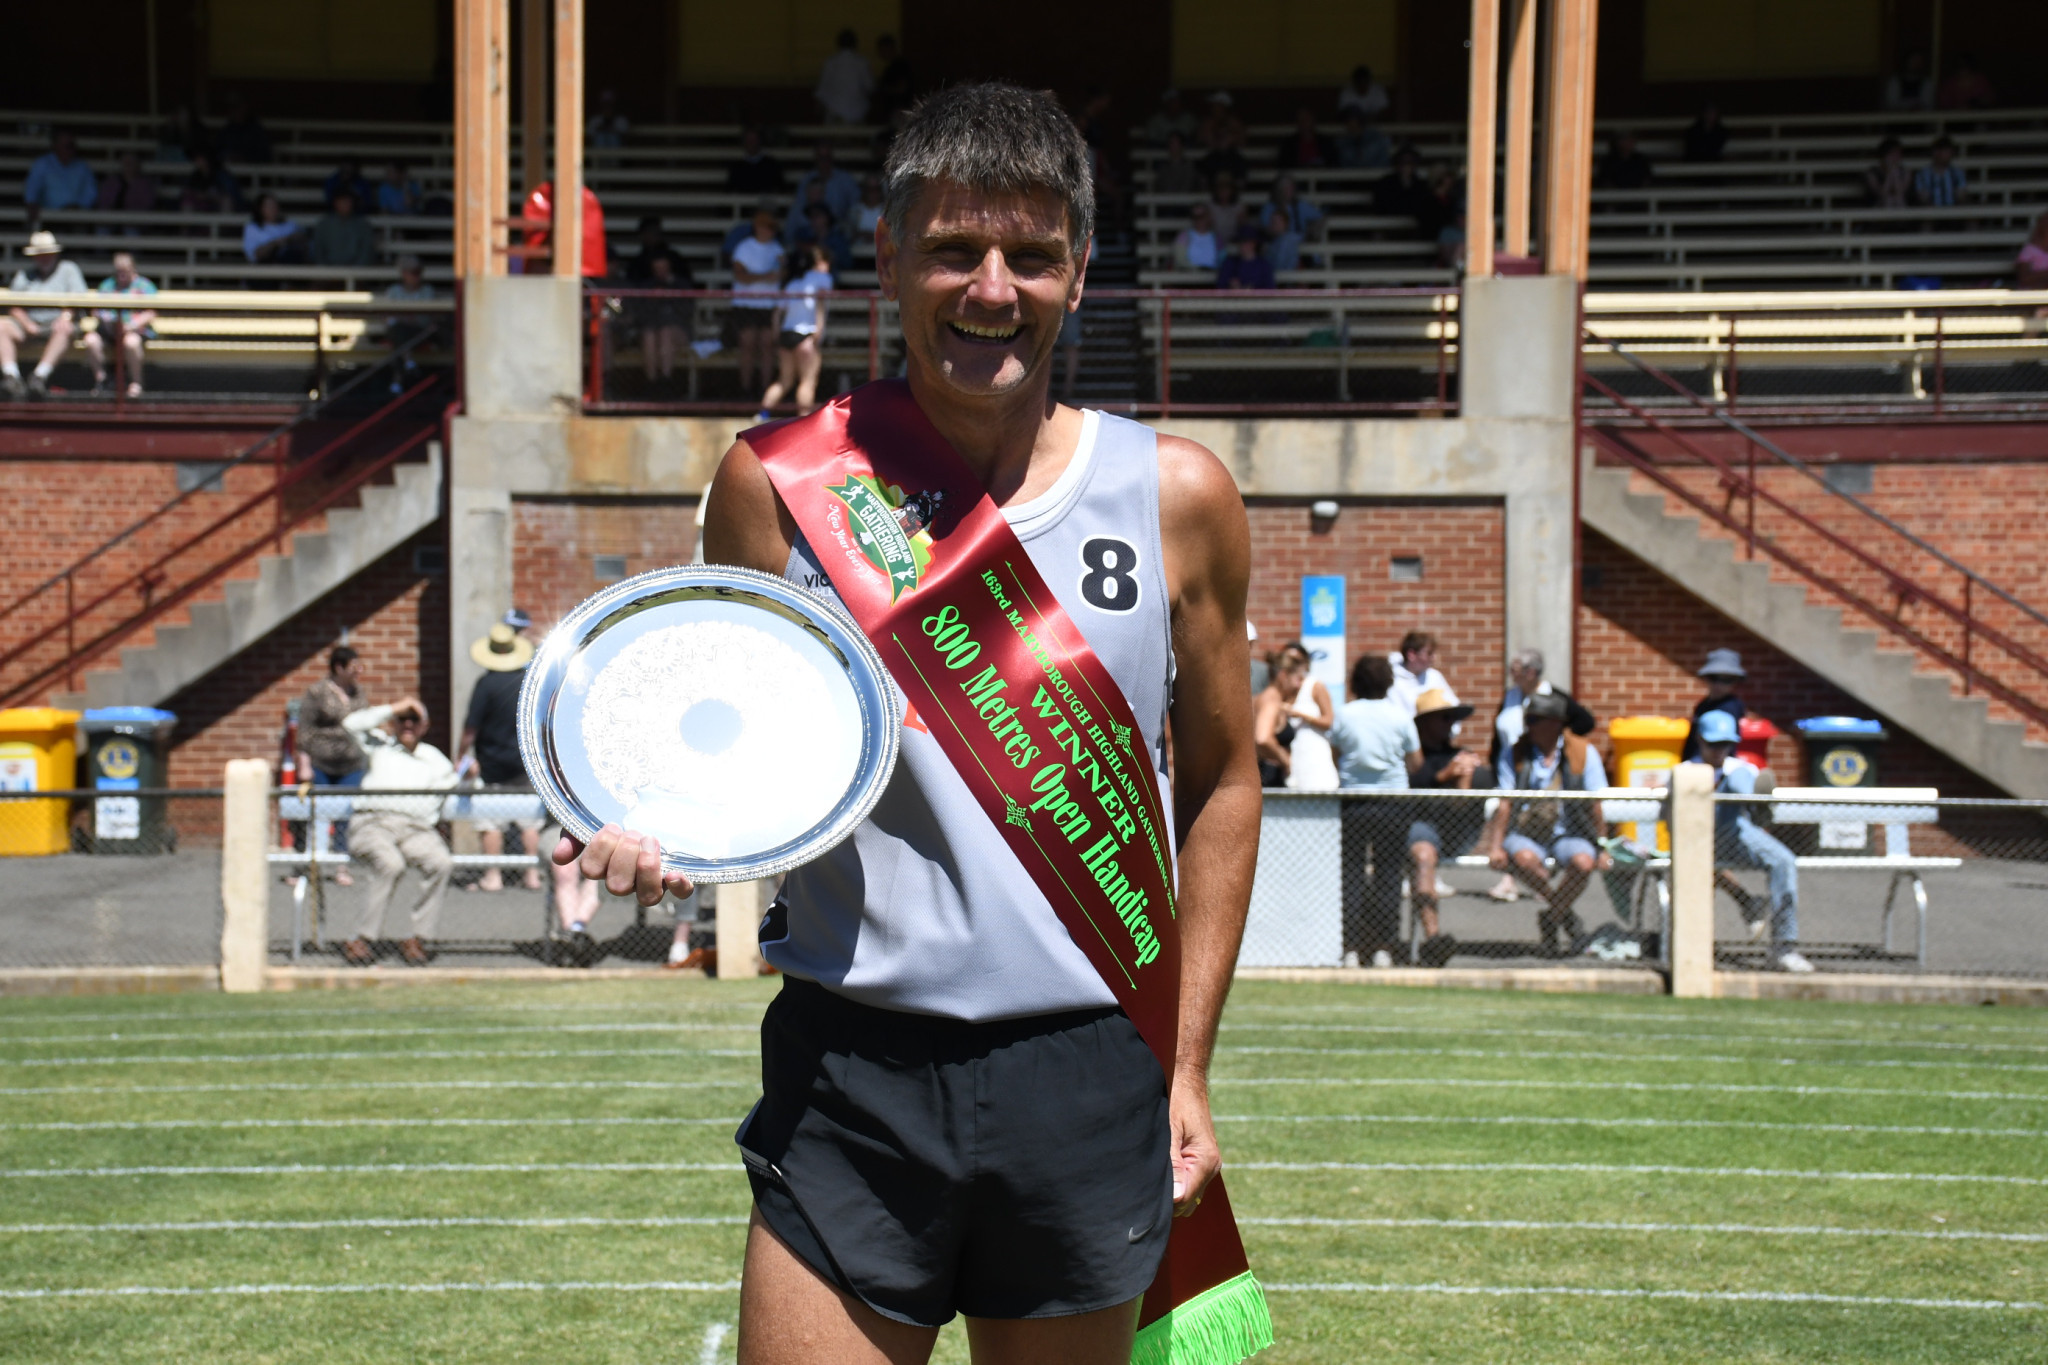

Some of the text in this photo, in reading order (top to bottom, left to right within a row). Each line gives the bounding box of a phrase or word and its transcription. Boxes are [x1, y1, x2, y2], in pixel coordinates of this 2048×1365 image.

[827, 504, 840, 529] New
[830, 527, 850, 549] Year
[859, 505, 902, 563] GATHERING
[865, 492, 912, 564] MARYBOROUGH HIGHLAND
[1078, 533, 1142, 615] 8
[980, 569, 1012, 610] 163rd
[1006, 609, 1093, 726] MARYBOROUGH
[1087, 724, 1140, 805] HIGHLAND
[1137, 805, 1168, 888] GATHERING
[1031, 684, 1137, 844] WINNER
[921, 605, 1161, 969] 800 Metres Open Handicap
